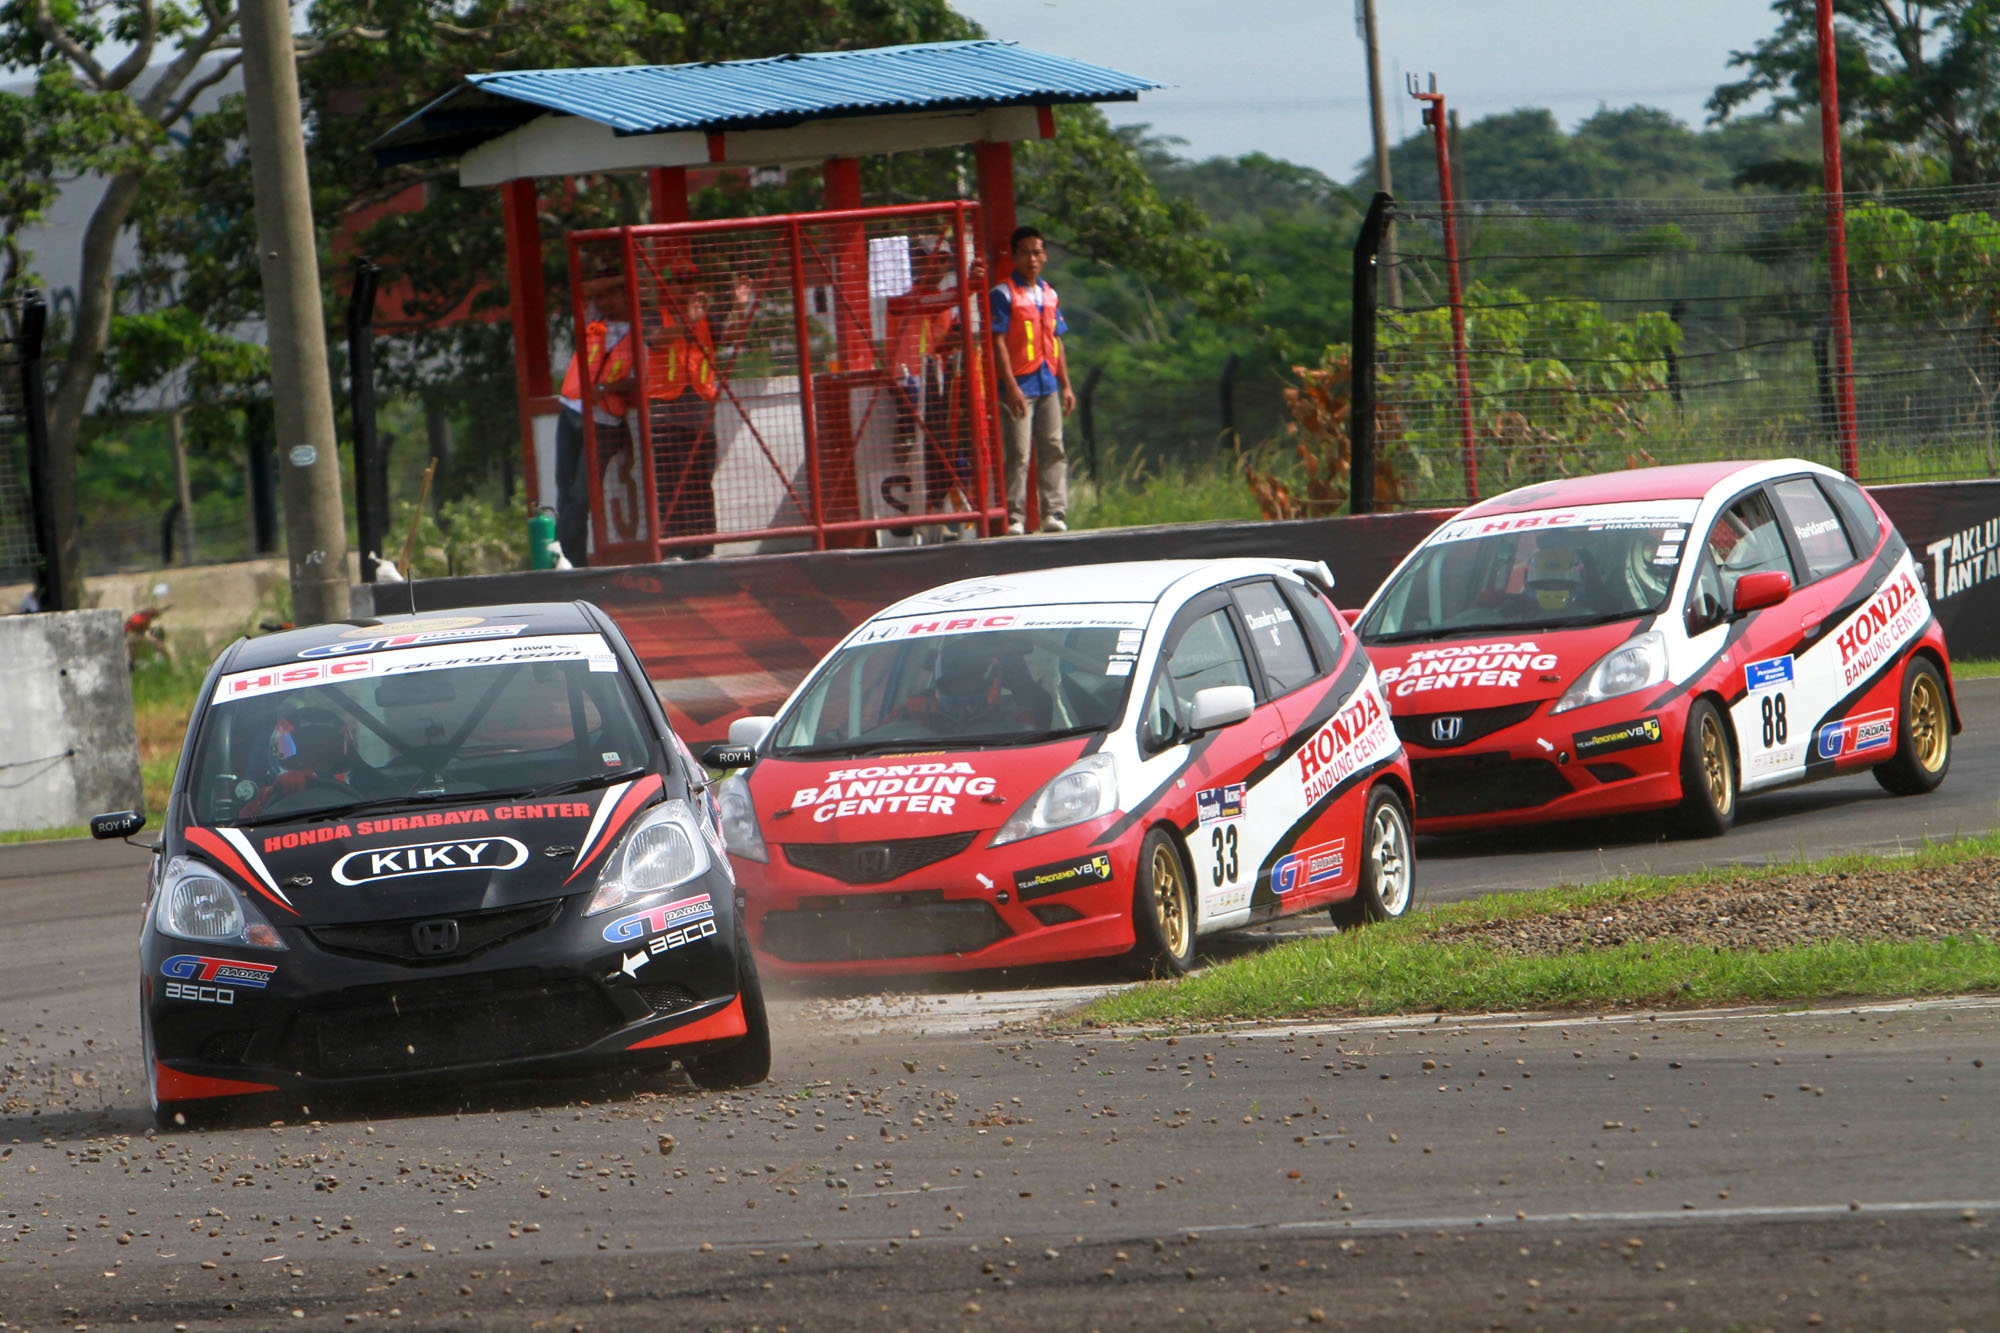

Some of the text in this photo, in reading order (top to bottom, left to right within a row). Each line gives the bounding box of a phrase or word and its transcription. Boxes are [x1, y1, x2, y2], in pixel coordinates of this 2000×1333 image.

[1482, 513, 1576, 533] HBC
[1604, 522, 1679, 530] HARIDARMA
[1794, 518, 1839, 541] Haridarma
[1926, 514, 2000, 600] TAKLU
[908, 615, 1015, 634] HBC
[1837, 571, 1917, 667] HONDA
[512, 644, 553, 652] HAWK
[1407, 641, 1541, 663] HONDA
[1844, 631, 1891, 687] BANDUNG
[234, 661, 369, 692] HSC
[1379, 653, 1558, 687] BANDUNG
[1396, 670, 1523, 697] CENTER
[1761, 691, 1788, 750] 88
[1858, 722, 1893, 741] RADIAL
[1297, 688, 1382, 785] HONDA
[719, 751, 751, 763] ROY H
[824, 762, 976, 783] HONDA
[1304, 751, 1354, 807] BANDUNG
[791, 776, 997, 809] BANDUNG
[813, 795, 956, 823] CENTER
[98, 818, 131, 832] ROY H
[264, 802, 591, 853] HONDA SURABAYA CENTER
[371, 842, 490, 874] KIKY
[1211, 823, 1239, 887] 33
[1310, 852, 1344, 873] RADIAL
[665, 902, 713, 921] RADIAL
[218, 967, 271, 981] RADIAL
